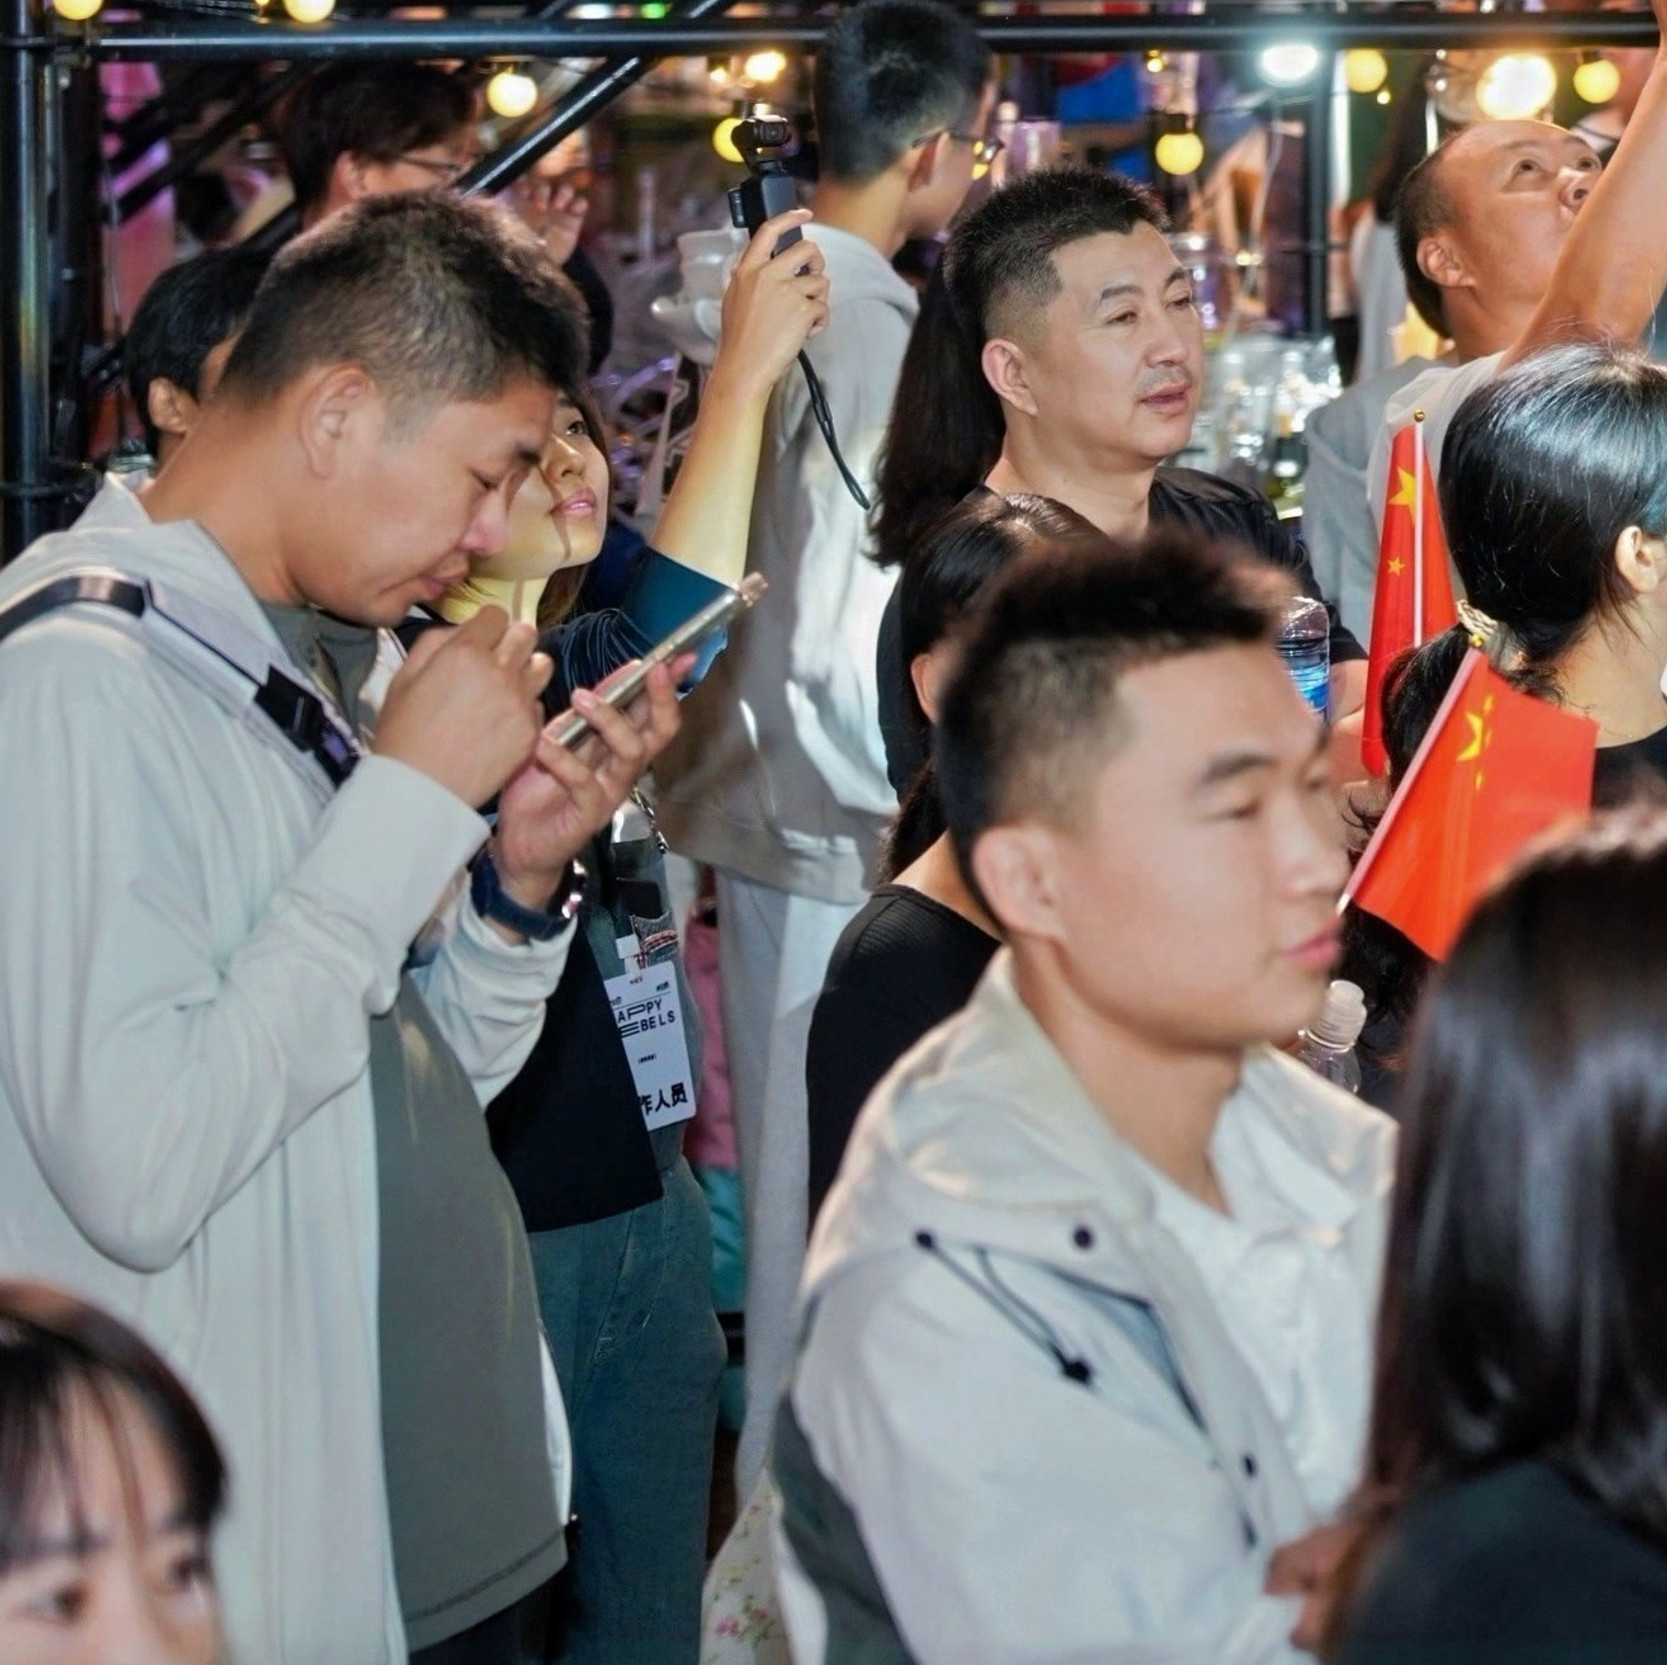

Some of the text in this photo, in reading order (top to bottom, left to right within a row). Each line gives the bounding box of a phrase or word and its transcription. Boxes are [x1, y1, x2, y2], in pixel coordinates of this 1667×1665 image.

[617, 998, 663, 1024] APPY
[618, 1010, 676, 1039] EBELS
[640, 1082, 688, 1116] 作人员
